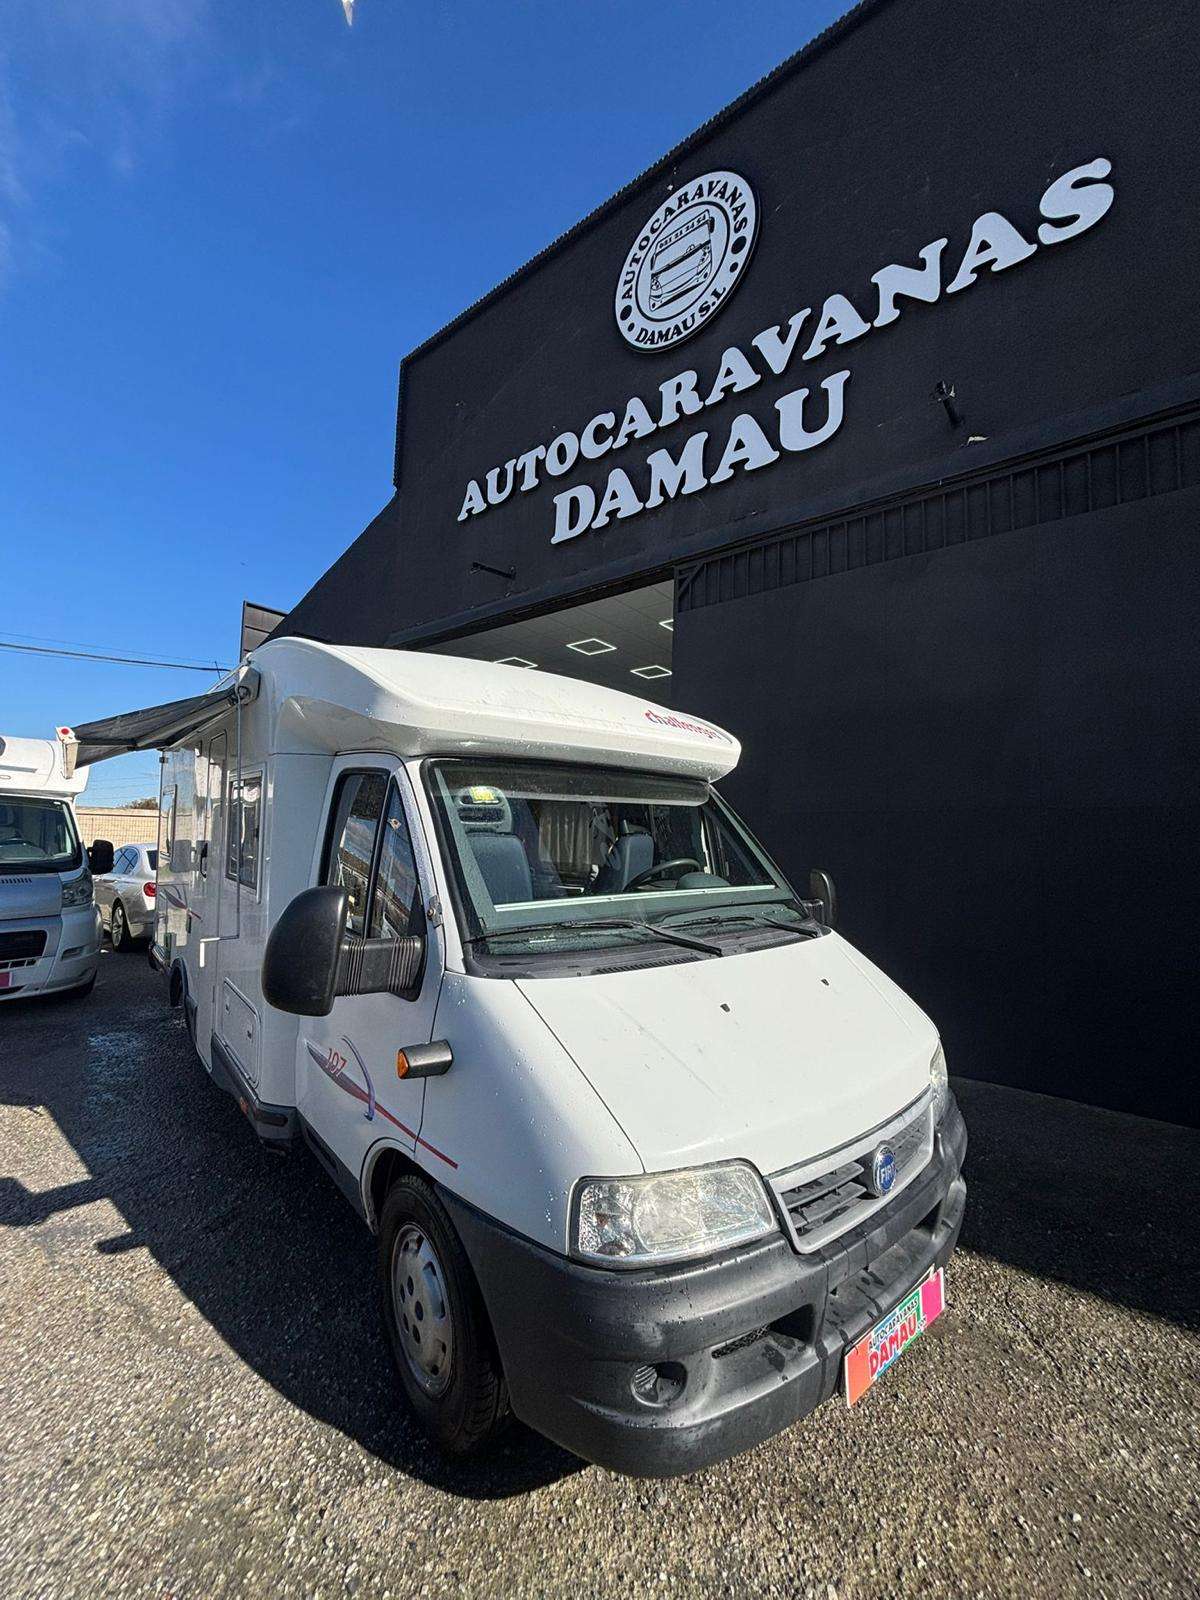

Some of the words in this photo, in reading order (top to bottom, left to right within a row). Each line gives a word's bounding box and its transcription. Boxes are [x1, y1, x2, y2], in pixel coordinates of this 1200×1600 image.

[621, 180, 748, 300] AUTOCARAVANAS
[457, 156, 1115, 522] AUTOCARAVANAS
[635, 313, 696, 345] DAMAU
[698, 286, 727, 318] S.L
[549, 369, 852, 545] DAMAU
[868, 1312, 918, 1378] DAMAU
